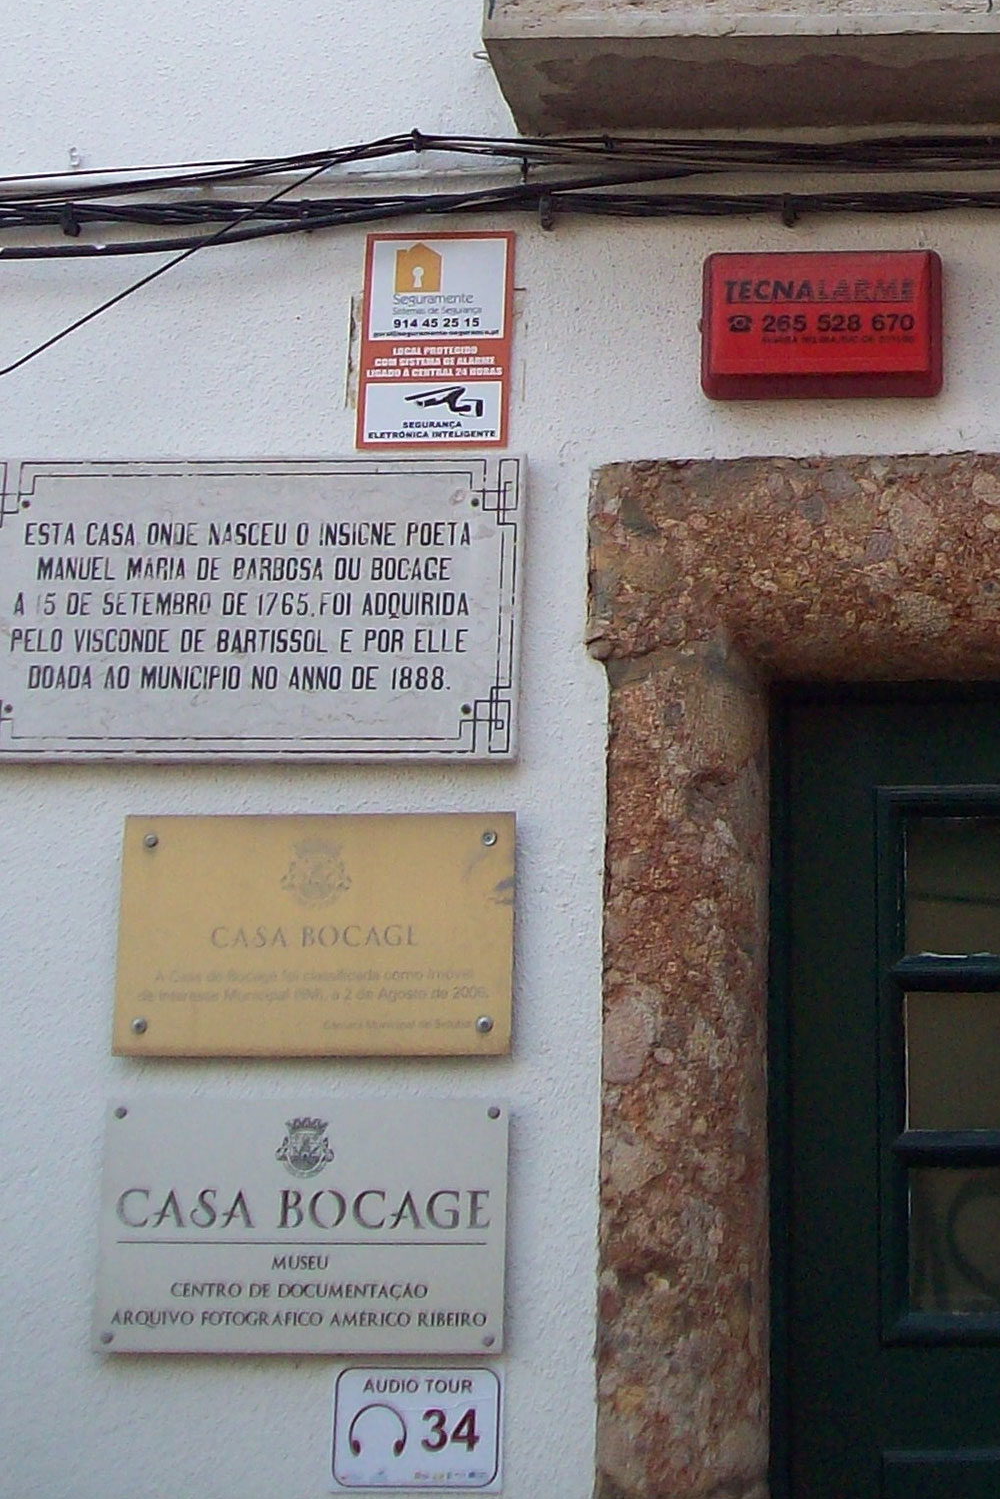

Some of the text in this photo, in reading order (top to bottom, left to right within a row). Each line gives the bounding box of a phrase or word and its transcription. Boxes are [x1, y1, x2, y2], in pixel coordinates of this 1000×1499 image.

[724, 278, 915, 300] TECNALARME
[393, 293, 474, 307] Seguramente
[393, 317, 480, 329] 914 45 25 15
[762, 313, 915, 333] 265 528 670
[402, 420, 462, 429] SEGURANÇA
[431, 429, 496, 438] INTELIGENTE
[24, 522, 471, 546] ESTA CASA ONDE NASCEU O INSIGNE POETA
[37, 557, 116, 581] MANUEL
[126, 557, 186, 581] MARIA
[196, 557, 221, 581] DE
[233, 557, 323, 581] BARBOSA
[370, 557, 452, 581] BOCAGE
[13, 592, 25, 616] A
[36, 592, 56, 616] 15
[66, 592, 92, 616] DE
[102, 592, 211, 616] SETEMBRO
[222, 592, 248, 616] DE
[362, 592, 469, 619] ADQUIRIDA
[10, 628, 469, 653] PELO VISCONDE DE BARTISSOL E POR ELLE
[28, 665, 451, 690] DOADA AO MUNICIPIO NO ANNO DE 1888.
[210, 925, 287, 948] CASA
[116, 1188, 491, 1230] CASA BOCAGE
[271, 1255, 329, 1271] MUSEU
[170, 1282, 428, 1301] CENTRO DE DOCUMENTAÇÃO
[110, 1311, 194, 1330] ARQUIVO
[329, 1310, 411, 1328] AMÉRICO
[416, 1312, 487, 1328] RIBEIRO
[362, 1378, 473, 1394] AUDIO TOUR
[420, 1407, 481, 1453] 34
